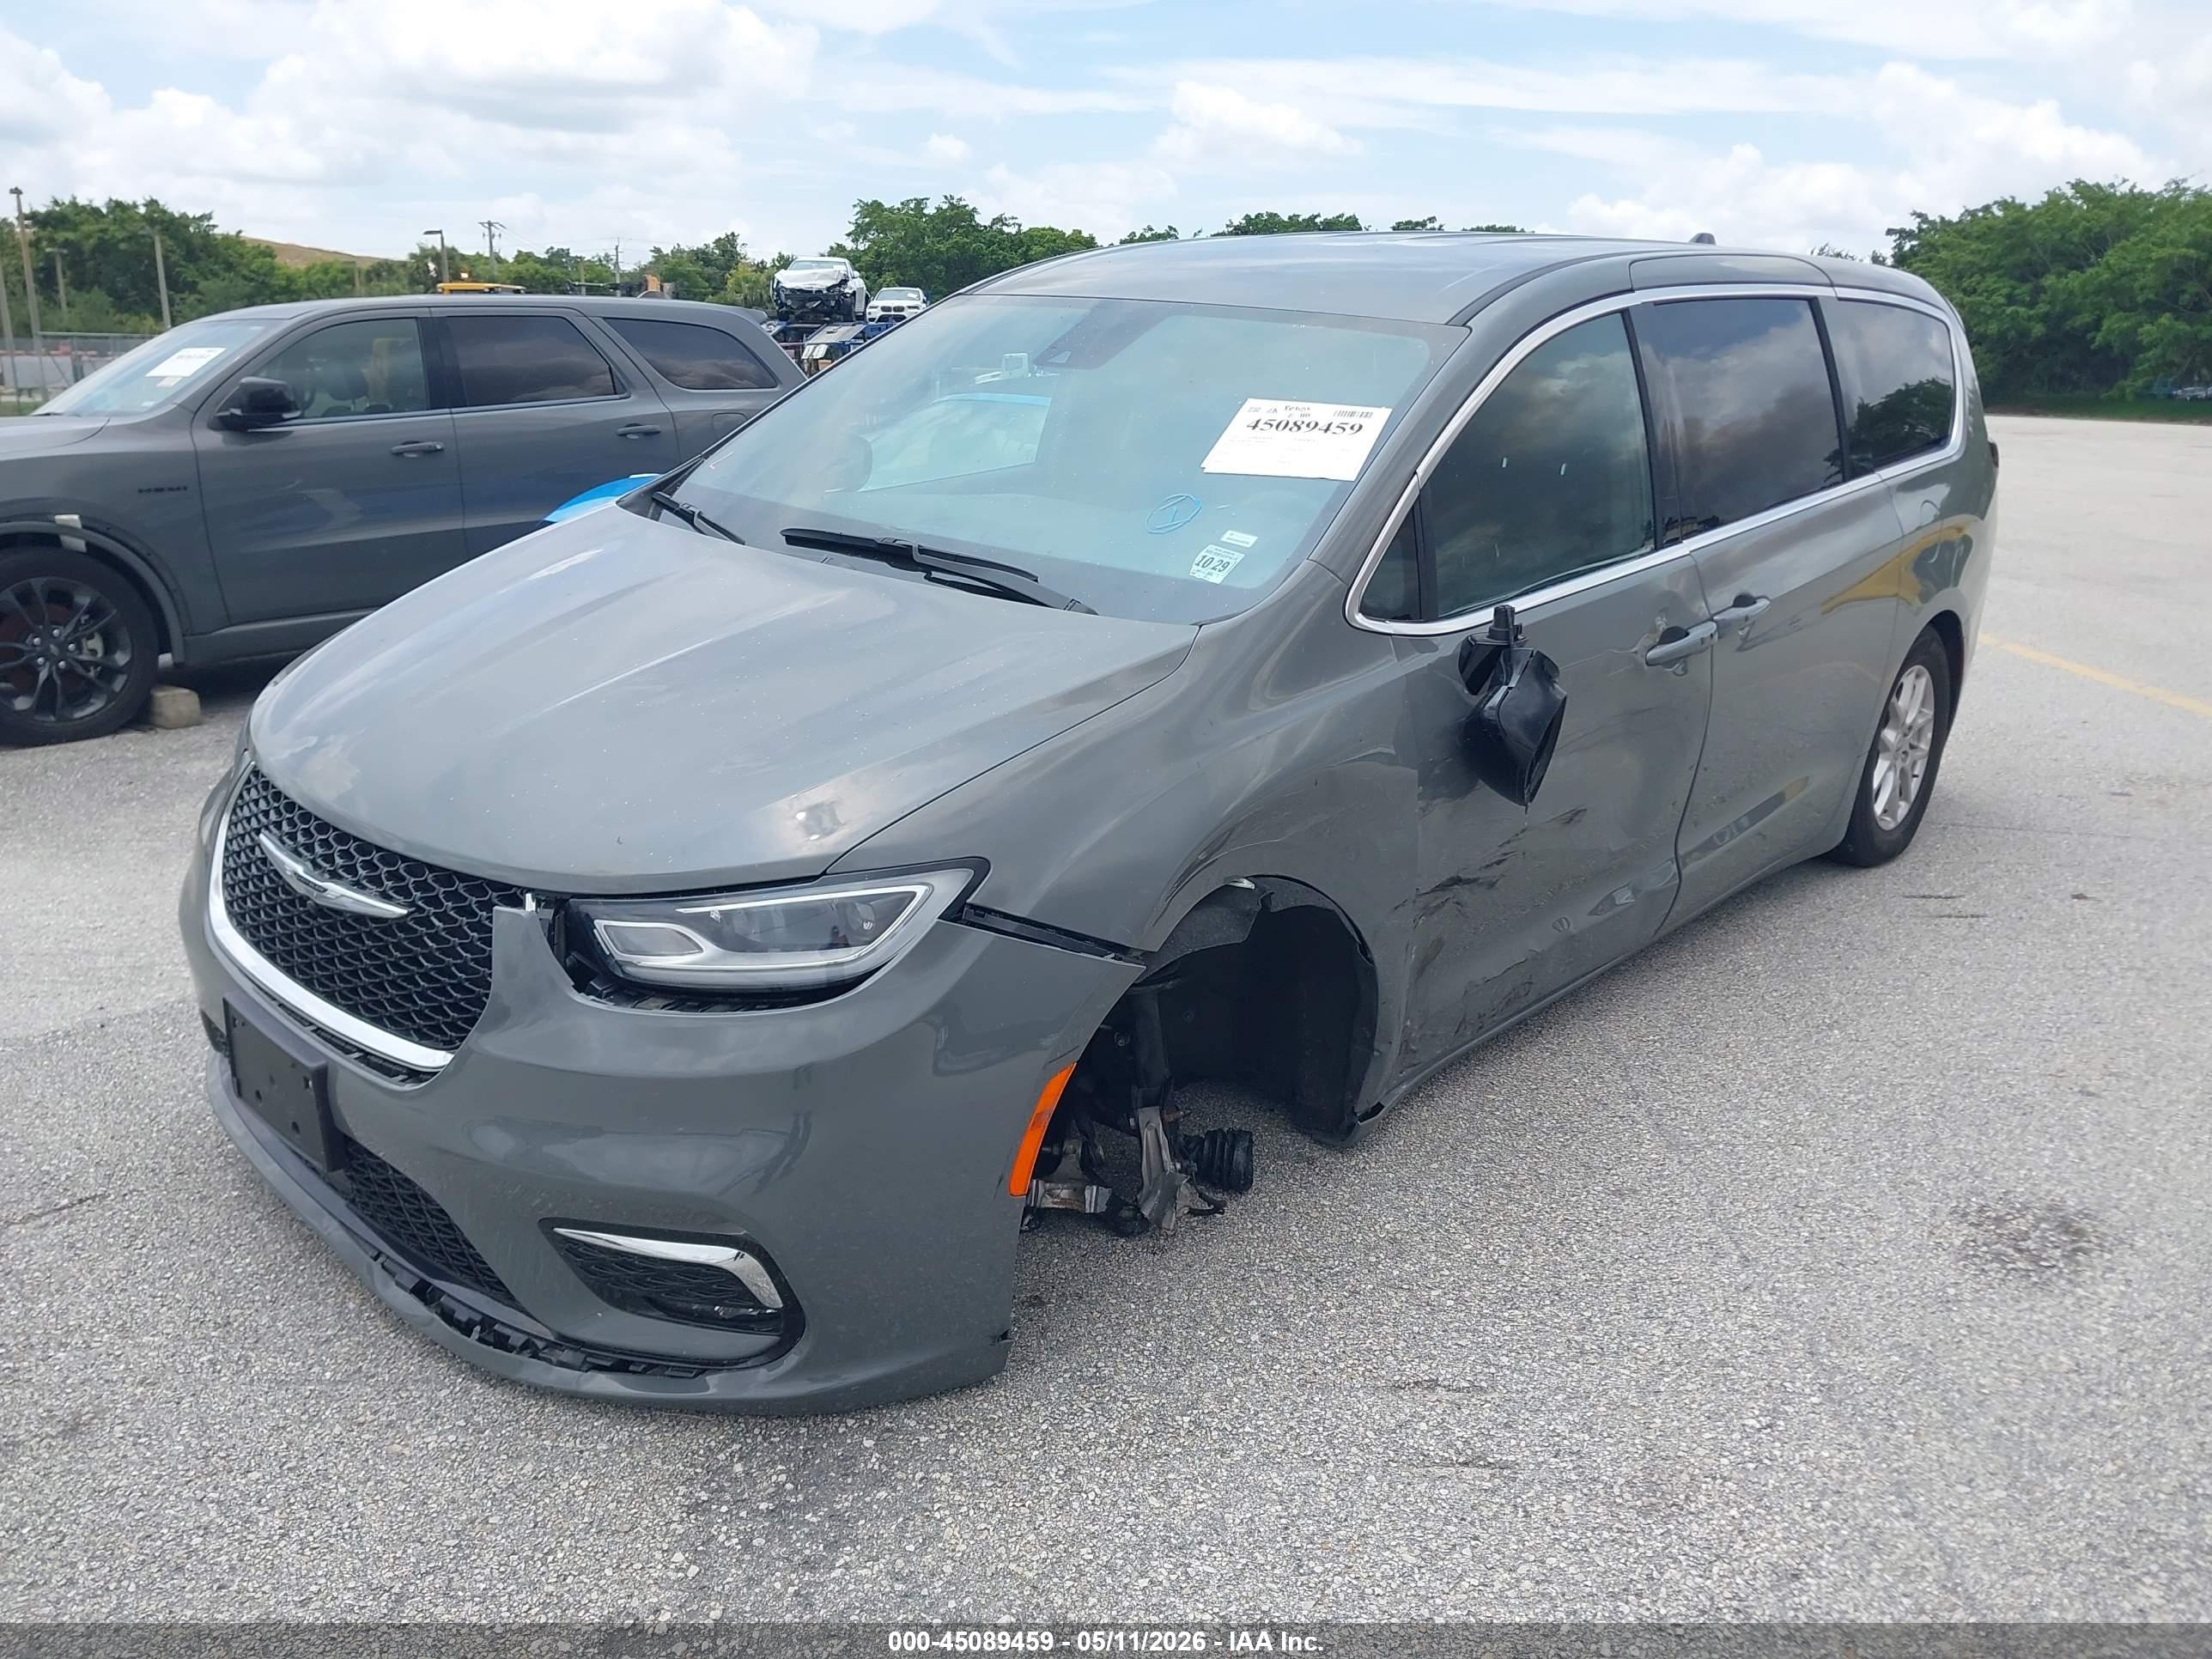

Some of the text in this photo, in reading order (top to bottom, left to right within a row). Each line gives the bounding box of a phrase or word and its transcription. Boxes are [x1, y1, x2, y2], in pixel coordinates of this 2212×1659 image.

[1246, 418, 1364, 435] 45089459
[1194, 555, 1231, 573] 10 29
